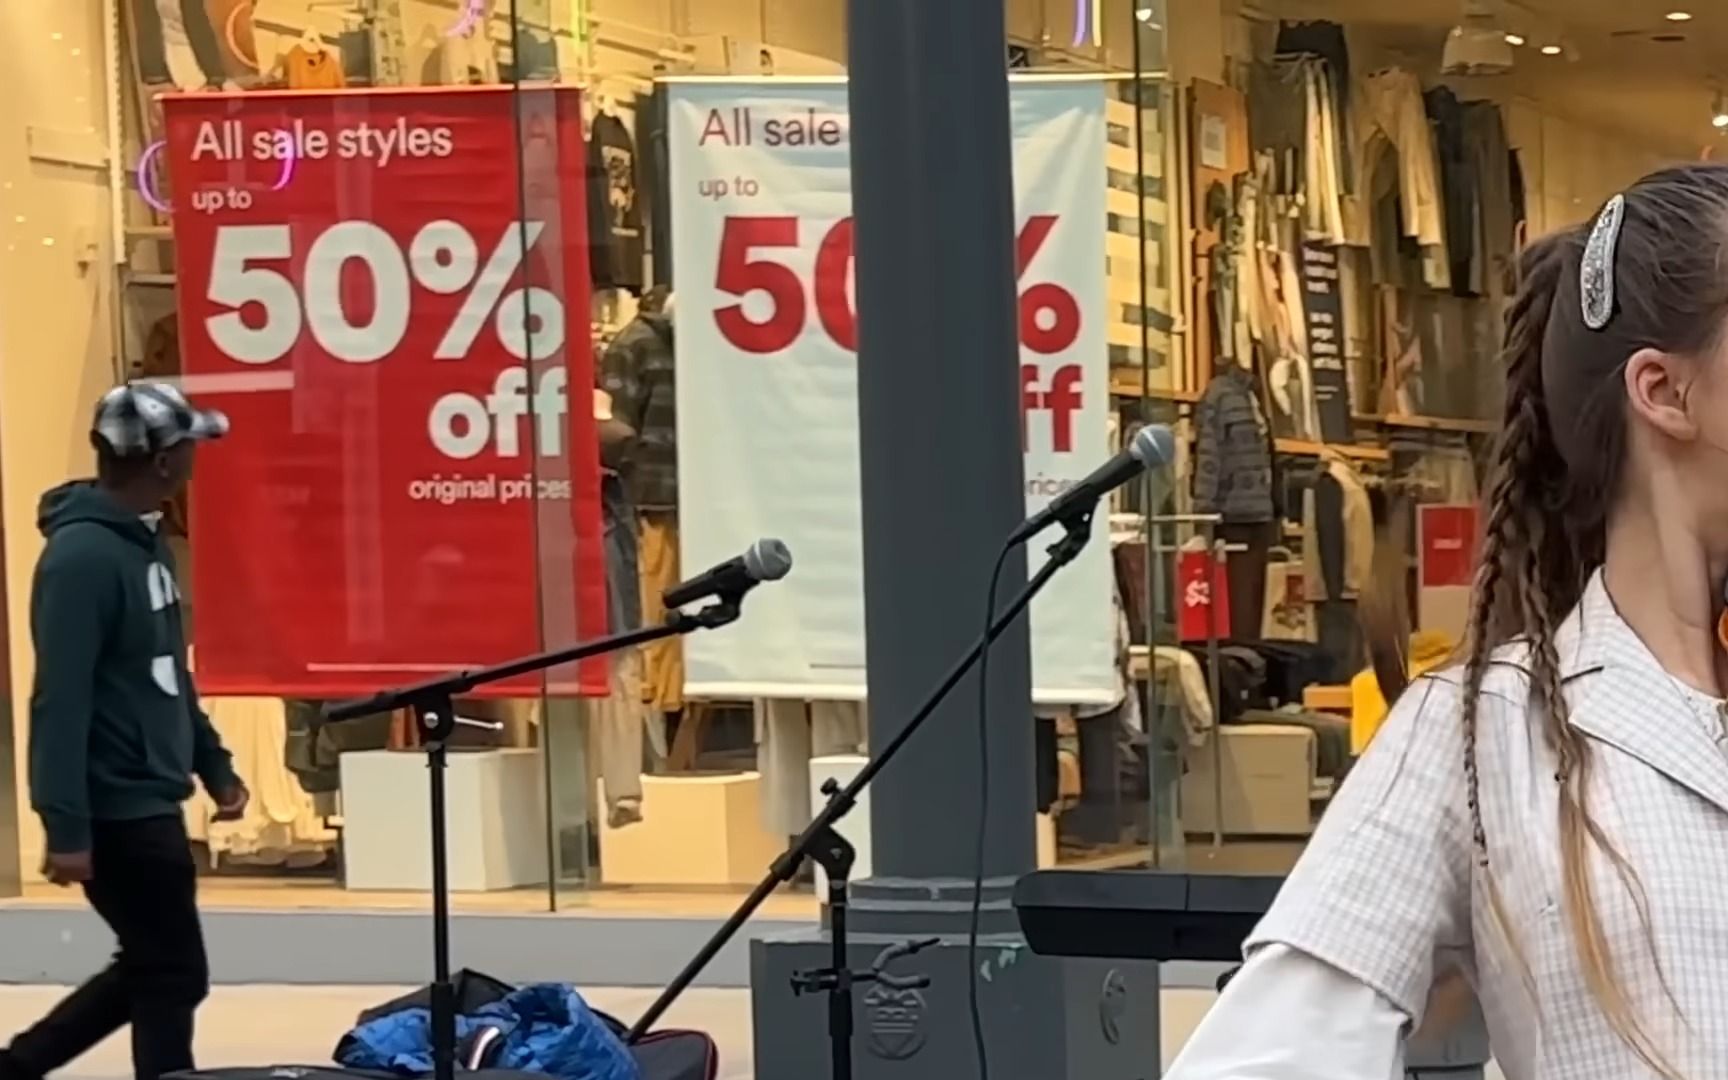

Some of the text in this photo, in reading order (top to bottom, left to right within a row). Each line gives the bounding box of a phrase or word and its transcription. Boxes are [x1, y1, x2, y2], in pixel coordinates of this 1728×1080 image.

[191, 117, 453, 168] All sale styles
[699, 108, 842, 147] All sale
[192, 187, 253, 214] up to
[698, 176, 759, 201] up to
[205, 219, 565, 364] 50%
[427, 367, 568, 459] off
[408, 472, 496, 505] original
